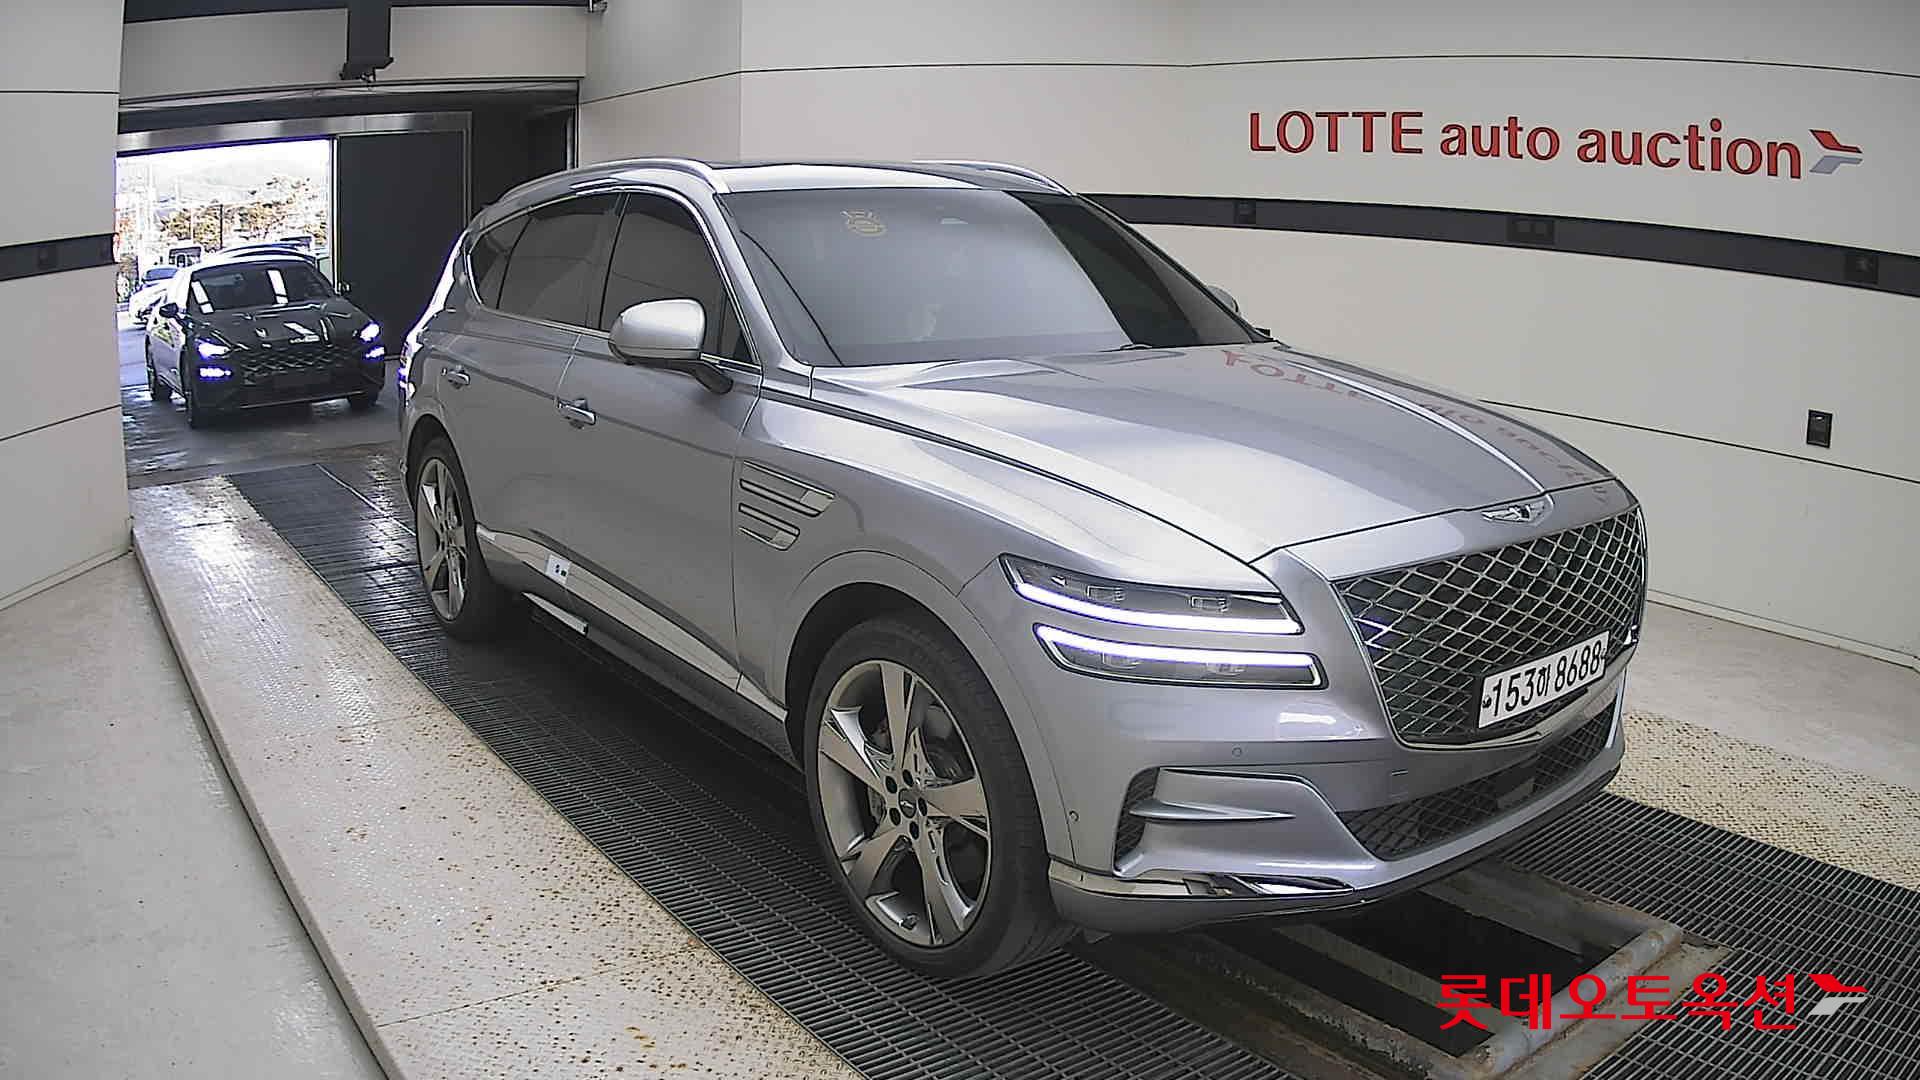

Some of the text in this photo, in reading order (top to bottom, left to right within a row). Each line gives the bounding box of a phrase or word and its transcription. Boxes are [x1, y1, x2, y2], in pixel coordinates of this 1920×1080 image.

[1249, 110, 1802, 179] LOTTE auto auction
[1554, 640, 1602, 692] 8688
